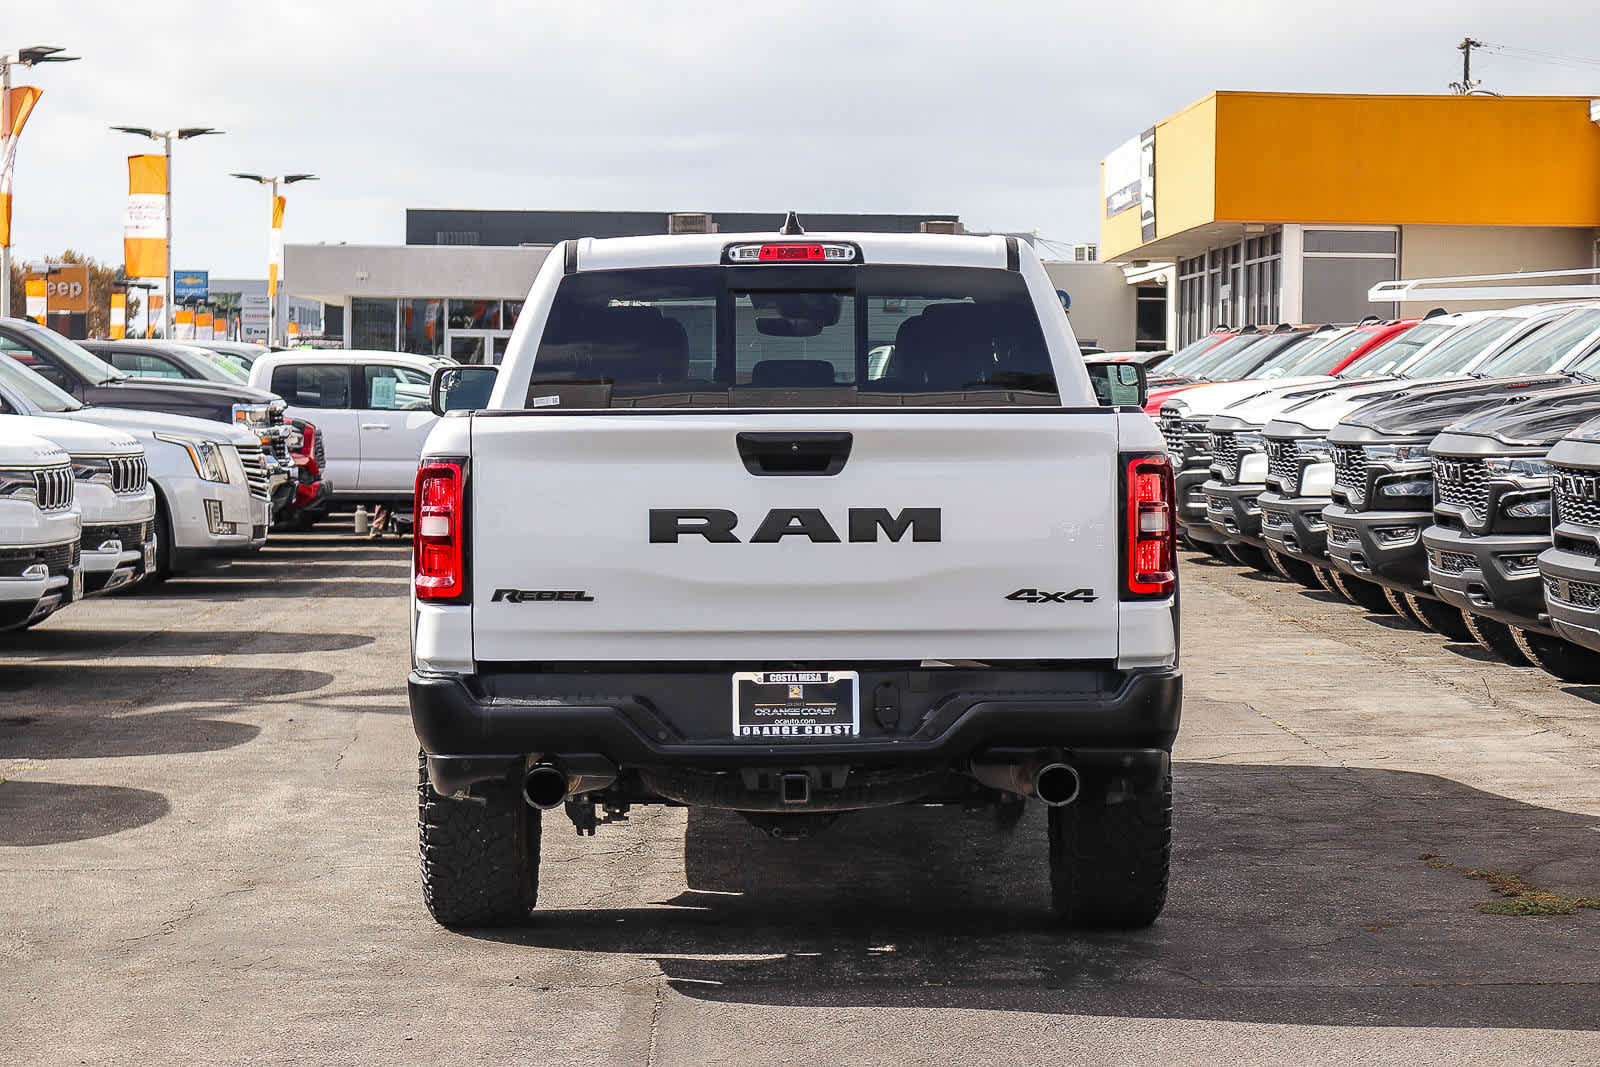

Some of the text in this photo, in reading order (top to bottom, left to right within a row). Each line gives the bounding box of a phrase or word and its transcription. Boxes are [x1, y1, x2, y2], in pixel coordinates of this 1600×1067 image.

[48, 281, 82, 298] eep
[649, 507, 941, 543] RAM
[491, 588, 594, 603] REBEL
[1004, 588, 1099, 603] 4x4
[769, 673, 822, 682] COSTA MESA
[754, 708, 837, 716] ORANGE COAST
[742, 726, 851, 735] ORANGE COAST
